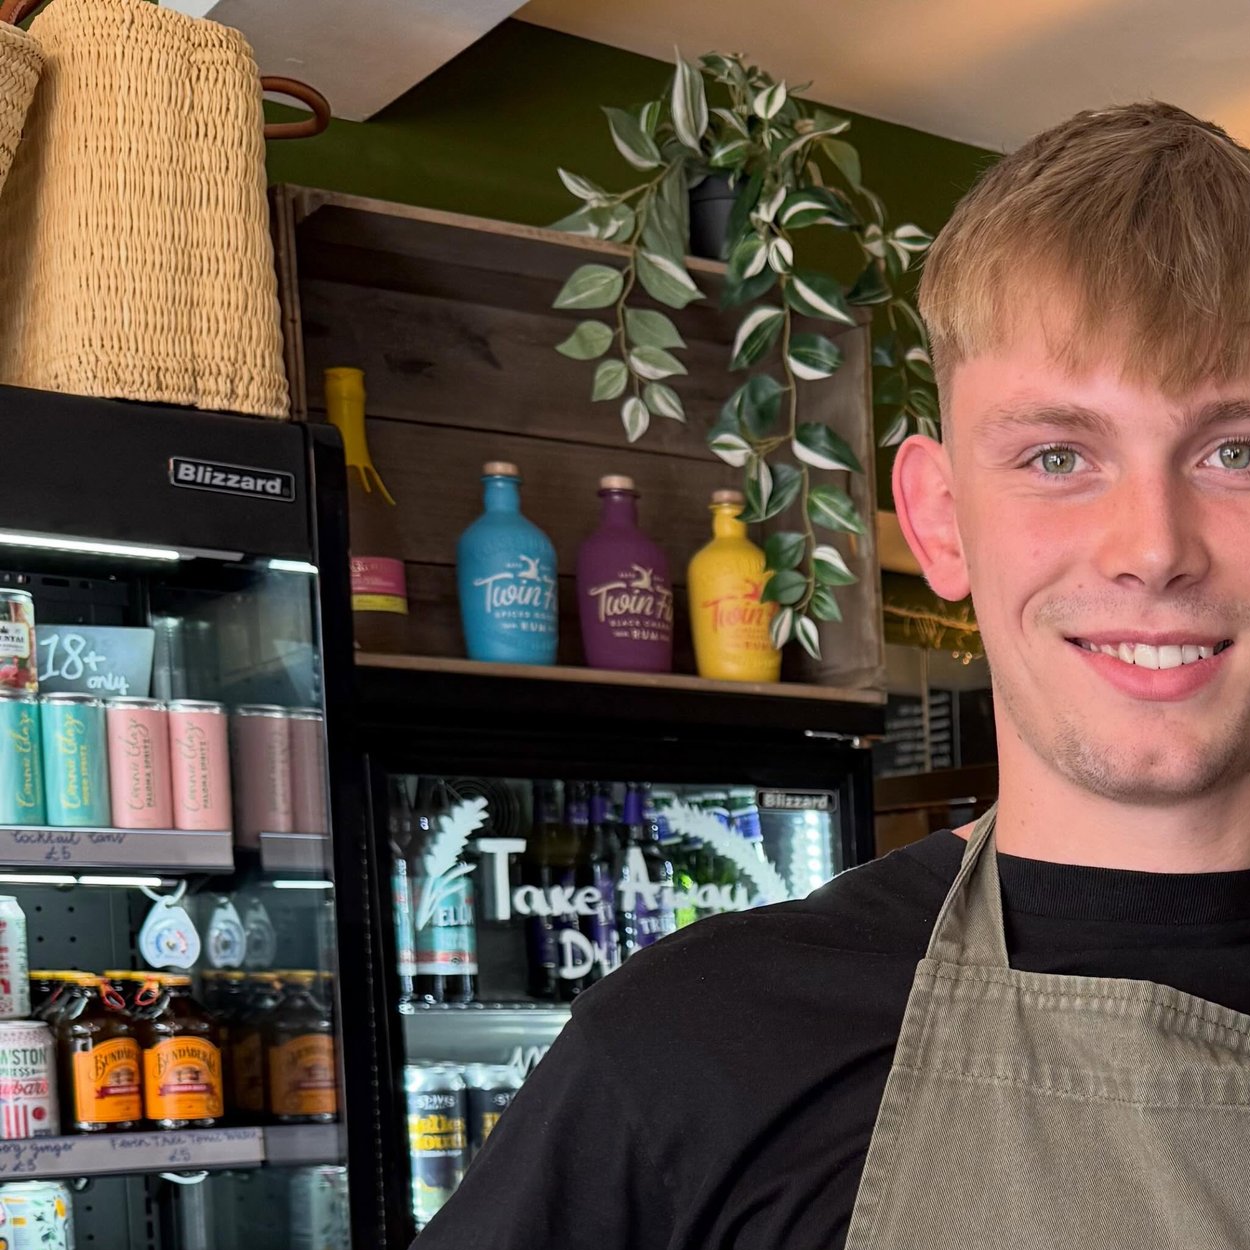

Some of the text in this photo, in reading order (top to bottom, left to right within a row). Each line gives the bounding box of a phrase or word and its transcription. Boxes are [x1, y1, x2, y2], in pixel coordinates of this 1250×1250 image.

[177, 463, 283, 496] Blizzard
[474, 572, 541, 613] Twin
[589, 582, 652, 622] Twin
[38, 633, 107, 682] 18+
[86, 672, 129, 696] only
[762, 793, 829, 808] Blizzard
[476, 838, 750, 921] Take Away
